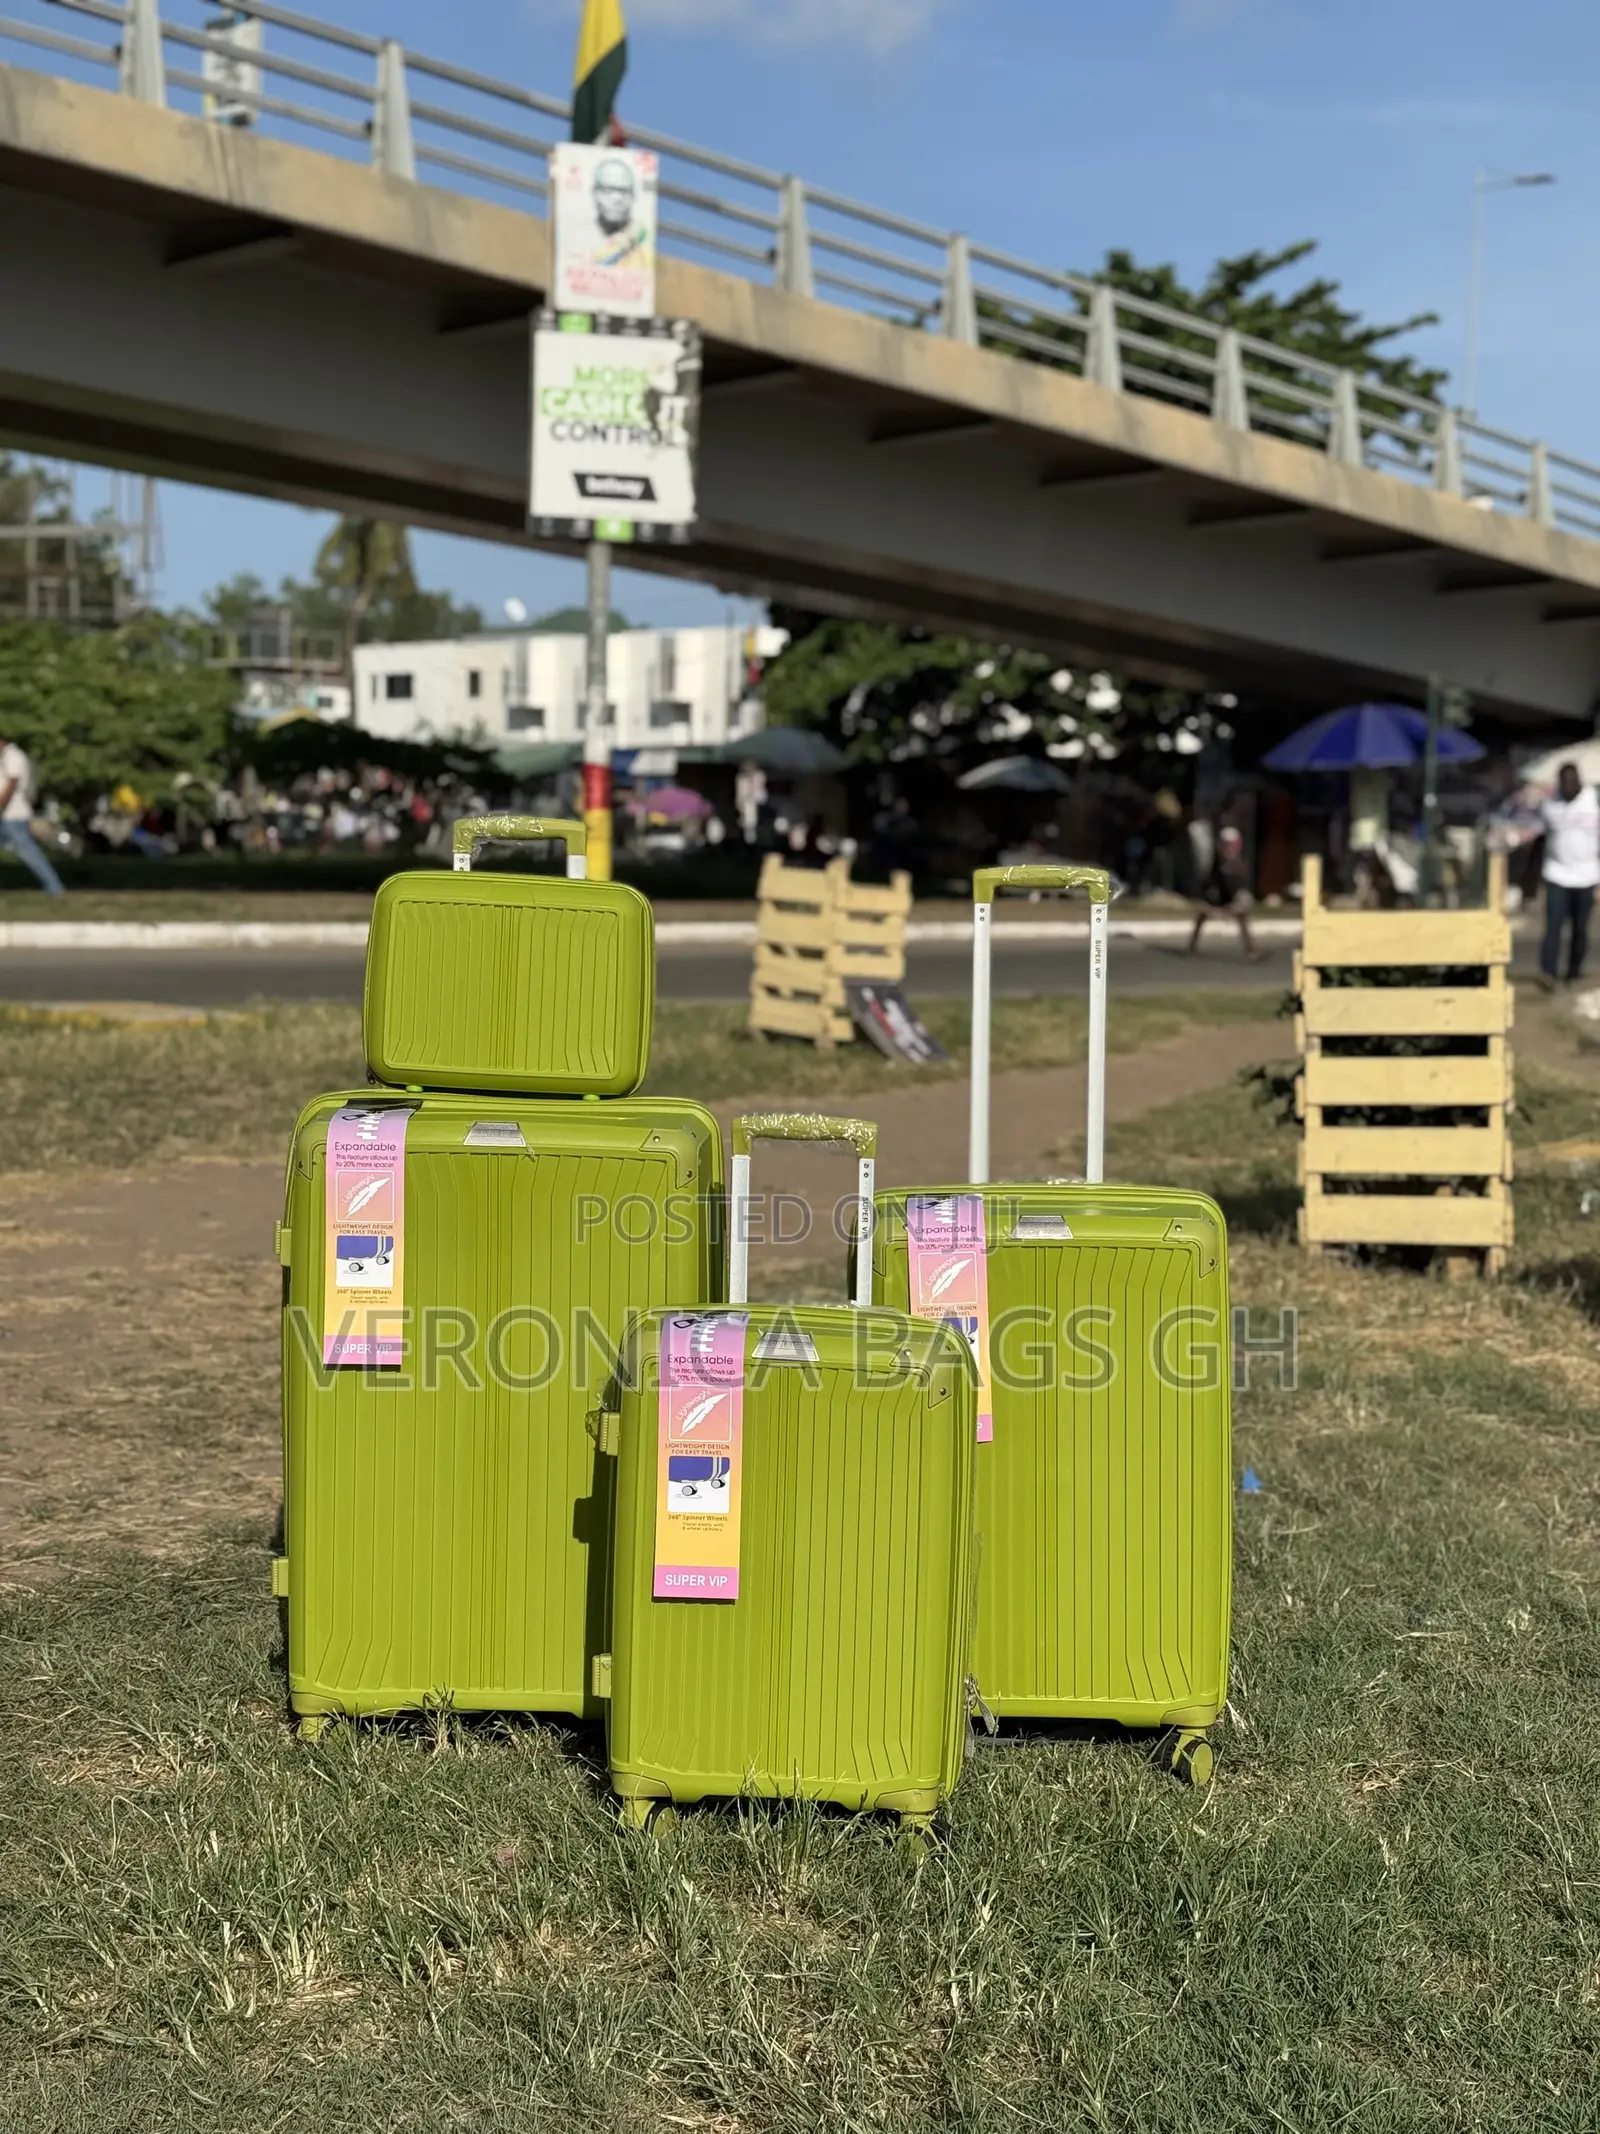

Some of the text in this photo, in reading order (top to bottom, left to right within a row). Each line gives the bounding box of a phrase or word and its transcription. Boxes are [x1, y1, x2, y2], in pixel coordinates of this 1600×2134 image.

[334, 1141, 397, 1153] Expandable
[861, 1197, 869, 1223] SUPER
[334, 1343, 393, 1354] SUPER VIP
[667, 1354, 734, 1365] Expandable
[664, 1573, 728, 1588] SUPER VIP
